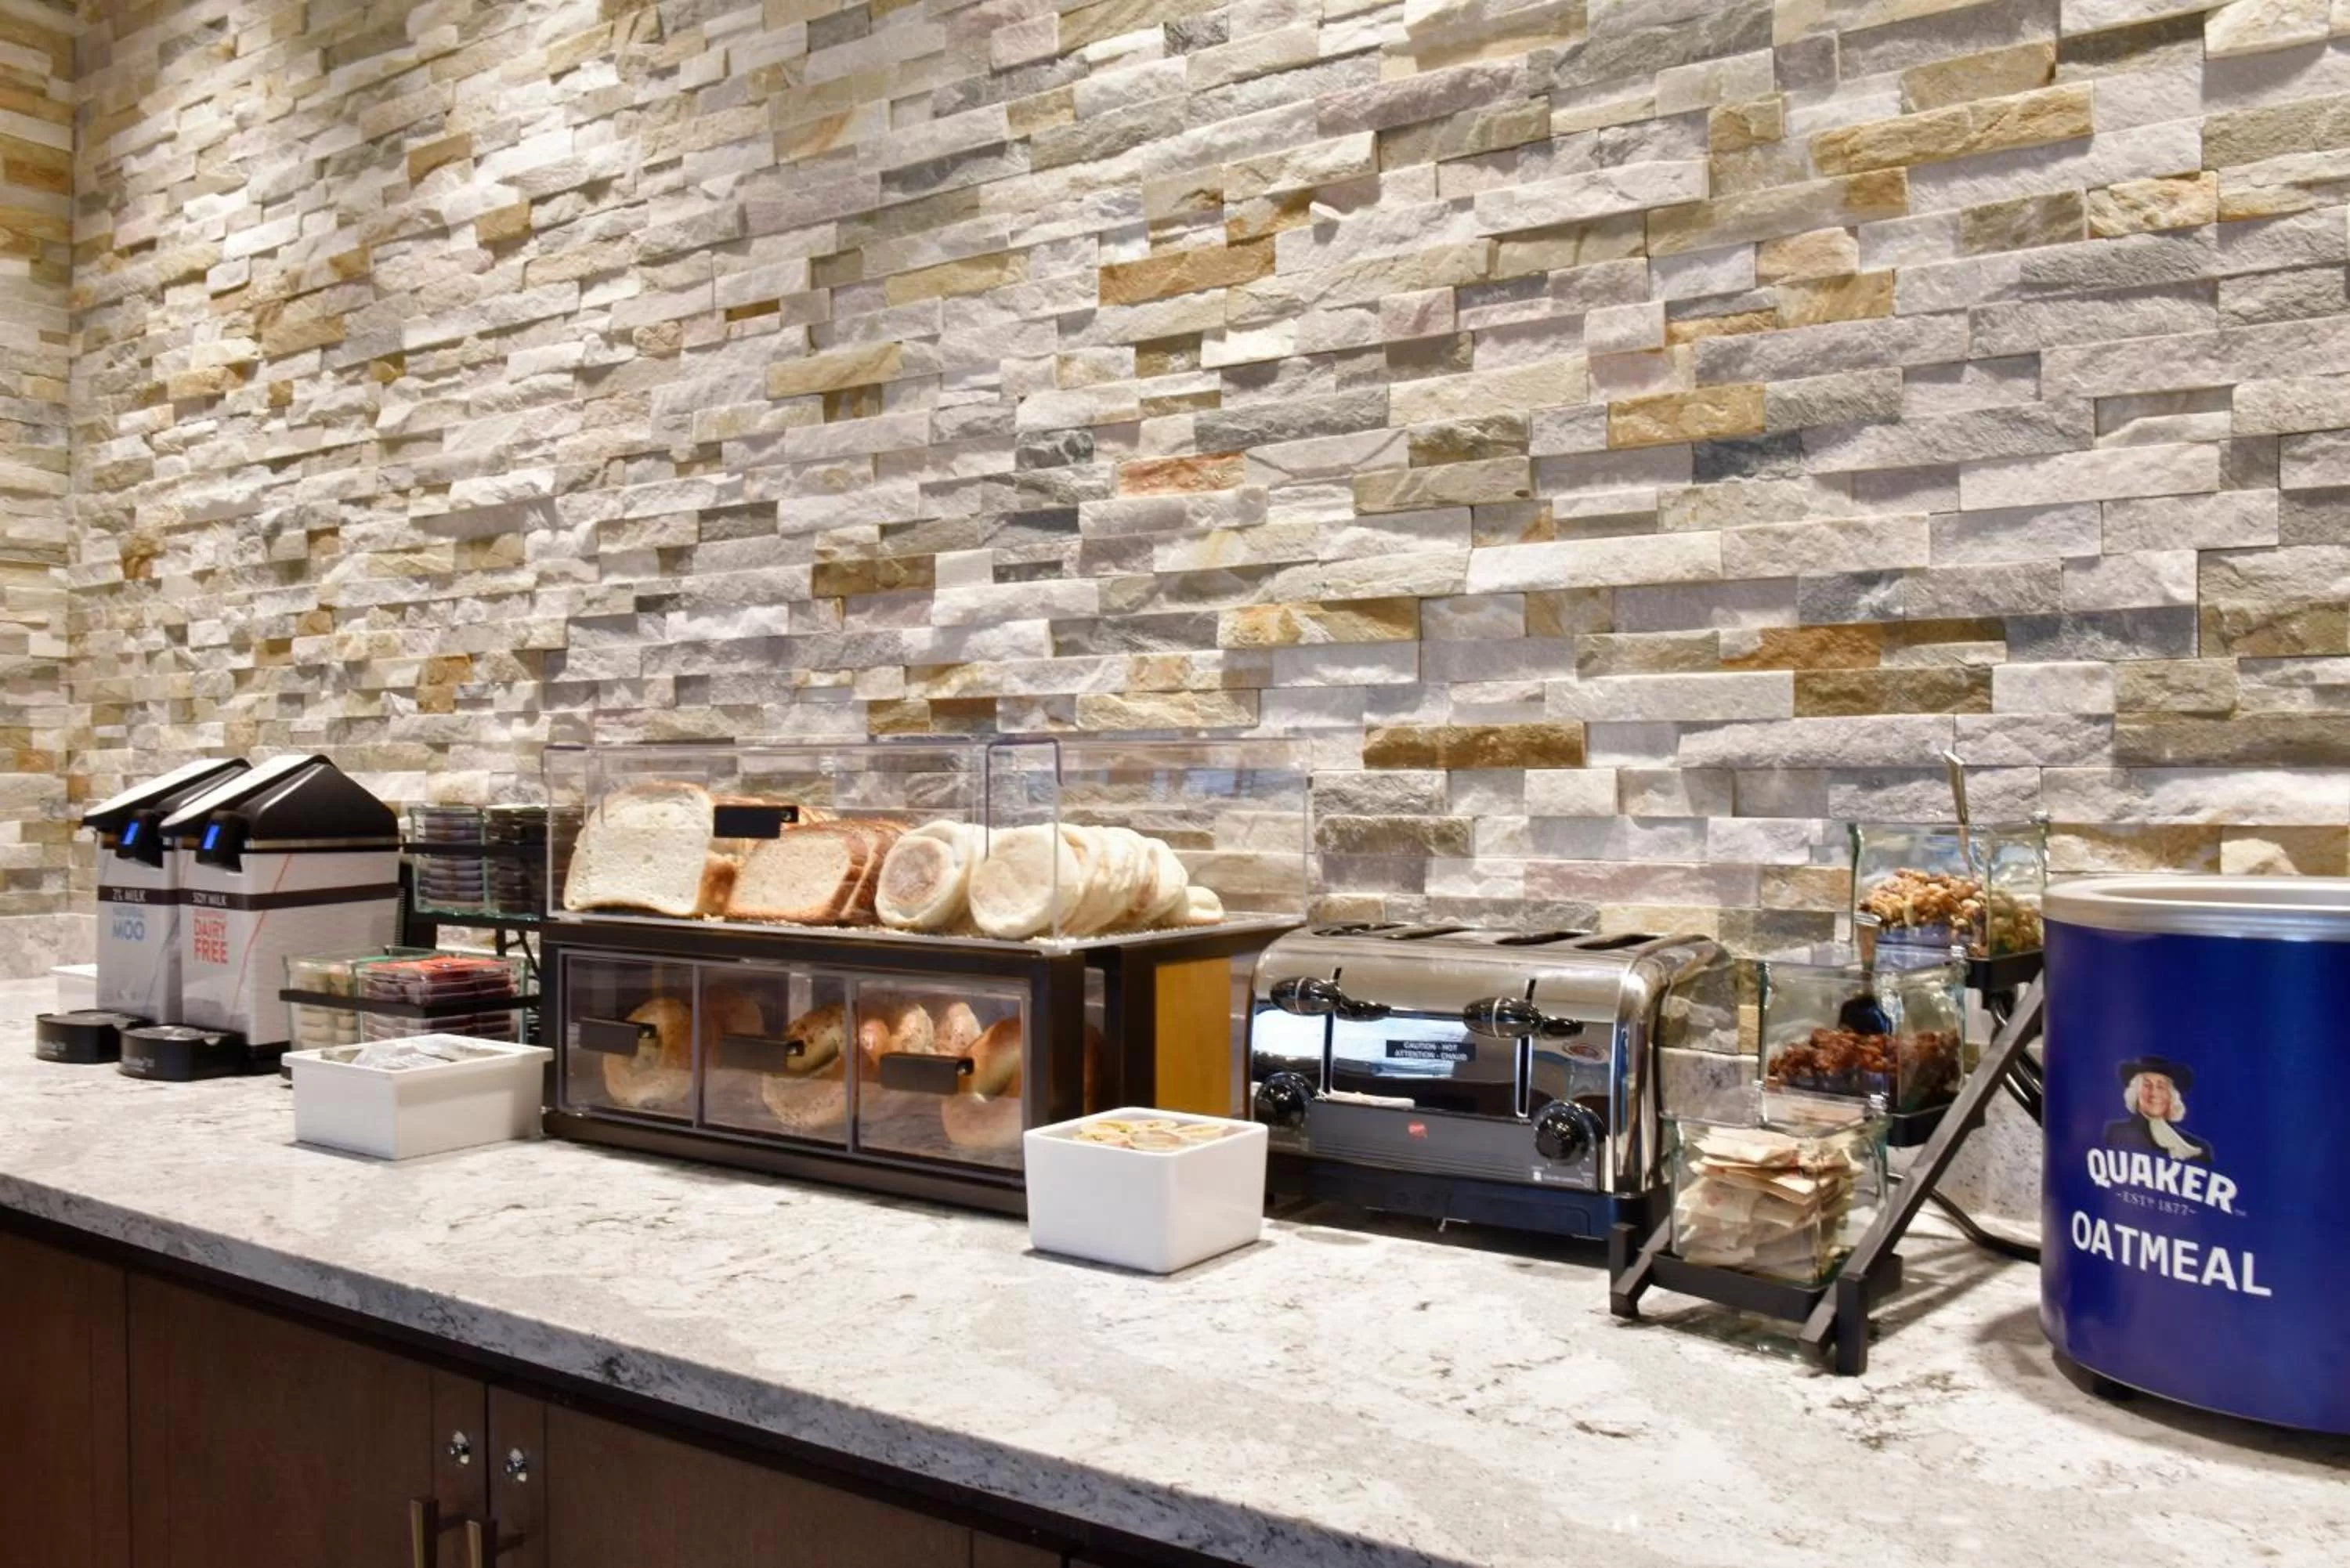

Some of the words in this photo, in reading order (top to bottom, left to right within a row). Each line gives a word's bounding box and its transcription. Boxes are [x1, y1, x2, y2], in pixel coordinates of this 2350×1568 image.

[208, 894, 227, 906] MILK
[113, 918, 145, 940] MOO
[193, 918, 227, 939] DAIRY
[193, 938, 228, 964] FREE
[1394, 1050, 1435, 1058] ATTENTION
[1403, 1041, 1437, 1050] CAUTION
[2087, 1147, 2238, 1215] QUAKER
[2071, 1210, 2272, 1297] OATMEAL
